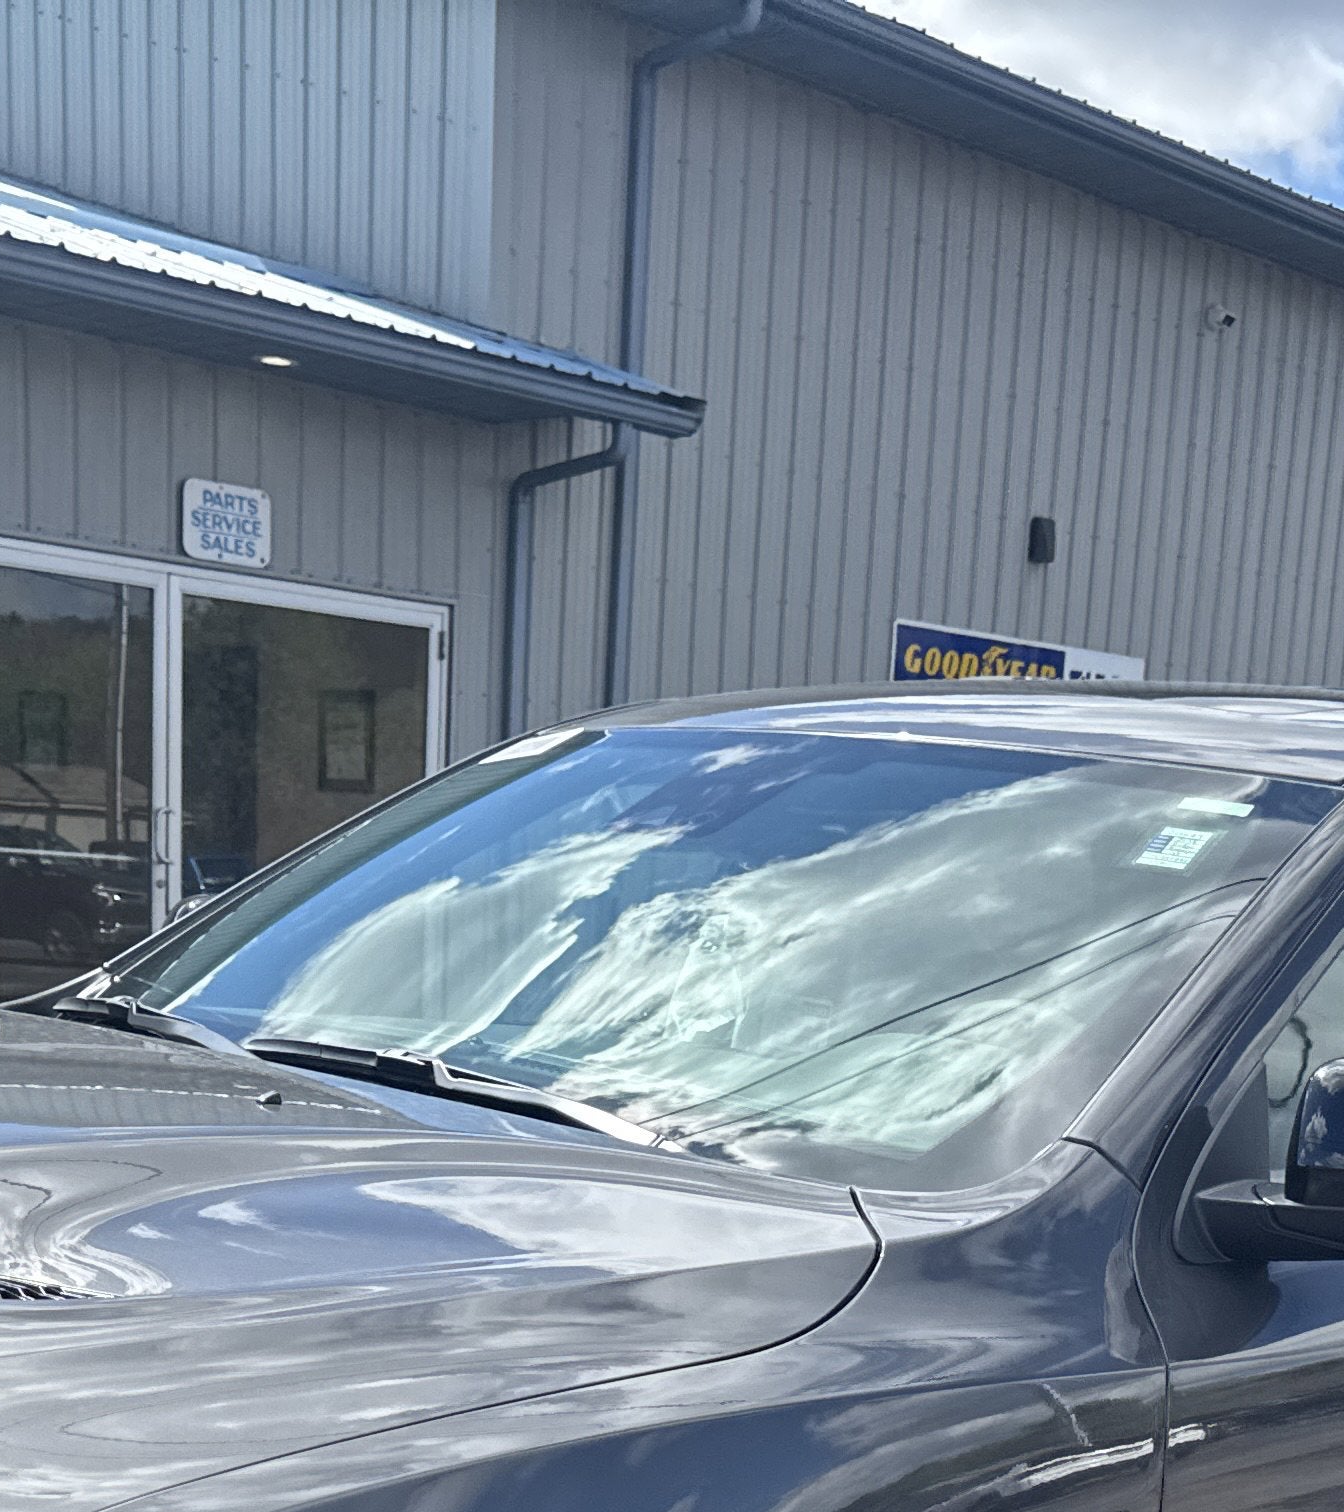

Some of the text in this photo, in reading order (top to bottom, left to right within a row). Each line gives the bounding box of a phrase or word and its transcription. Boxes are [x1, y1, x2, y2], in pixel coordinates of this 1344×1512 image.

[202, 490, 259, 515] PARTS
[191, 510, 262, 537] SERVICE
[200, 534, 256, 558] SALES
